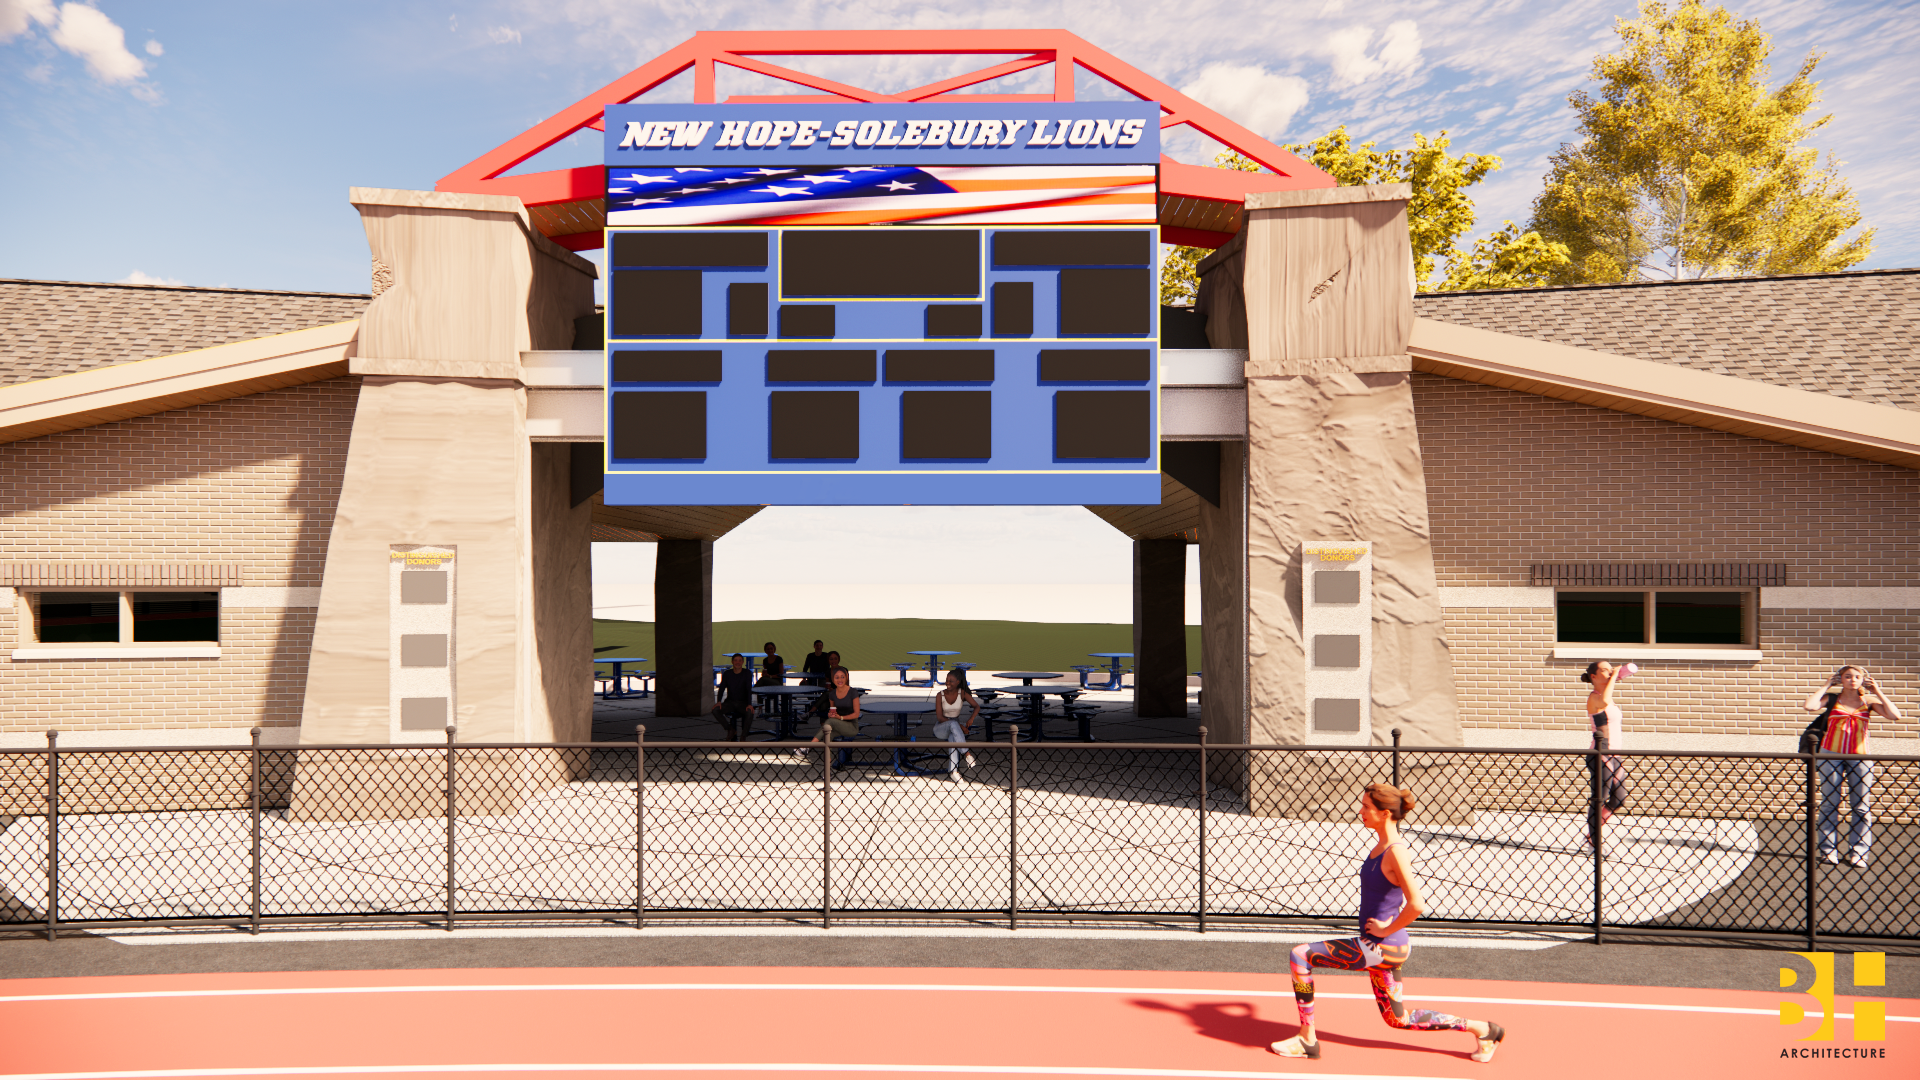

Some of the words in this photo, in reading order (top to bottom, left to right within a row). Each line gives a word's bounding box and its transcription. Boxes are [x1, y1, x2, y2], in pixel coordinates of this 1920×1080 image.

[618, 120, 715, 150] NEW
[713, 119, 1028, 150] HOPE-SOLEBURY
[1024, 118, 1147, 149] LIONS
